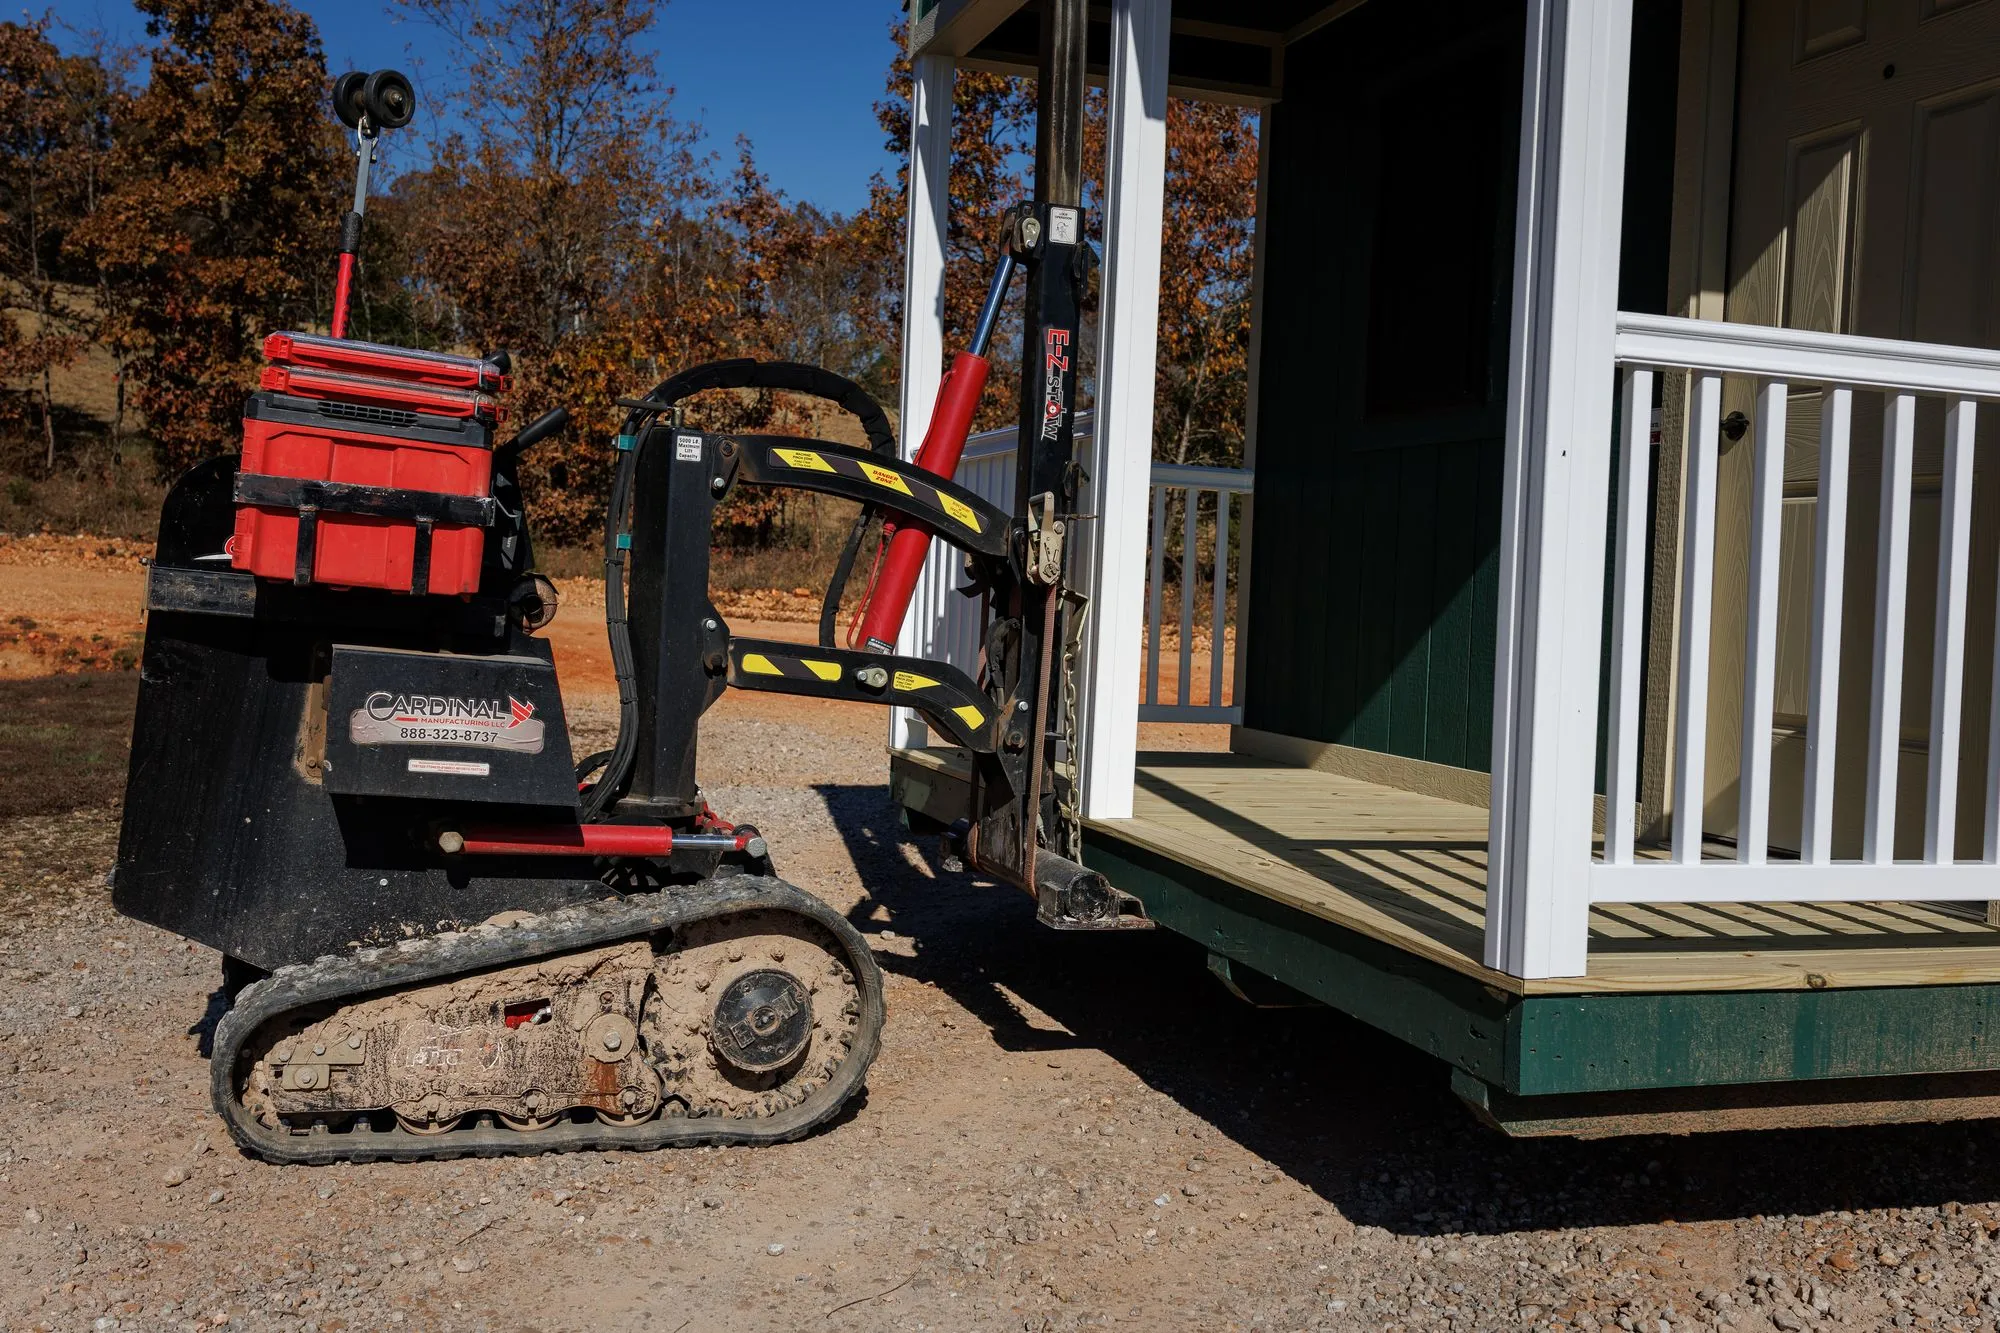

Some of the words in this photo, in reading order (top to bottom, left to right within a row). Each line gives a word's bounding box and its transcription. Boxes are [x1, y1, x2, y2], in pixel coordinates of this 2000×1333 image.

[1047, 328, 1070, 371] E-Z
[872, 470, 898, 481] DANGER
[875, 476, 896, 486] ZONE!
[365, 692, 507, 722] CARDINAL
[420, 717, 490, 728] MANUFACTURING
[491, 721, 506, 729] LLC
[400, 727, 498, 743] 888-323-8737
